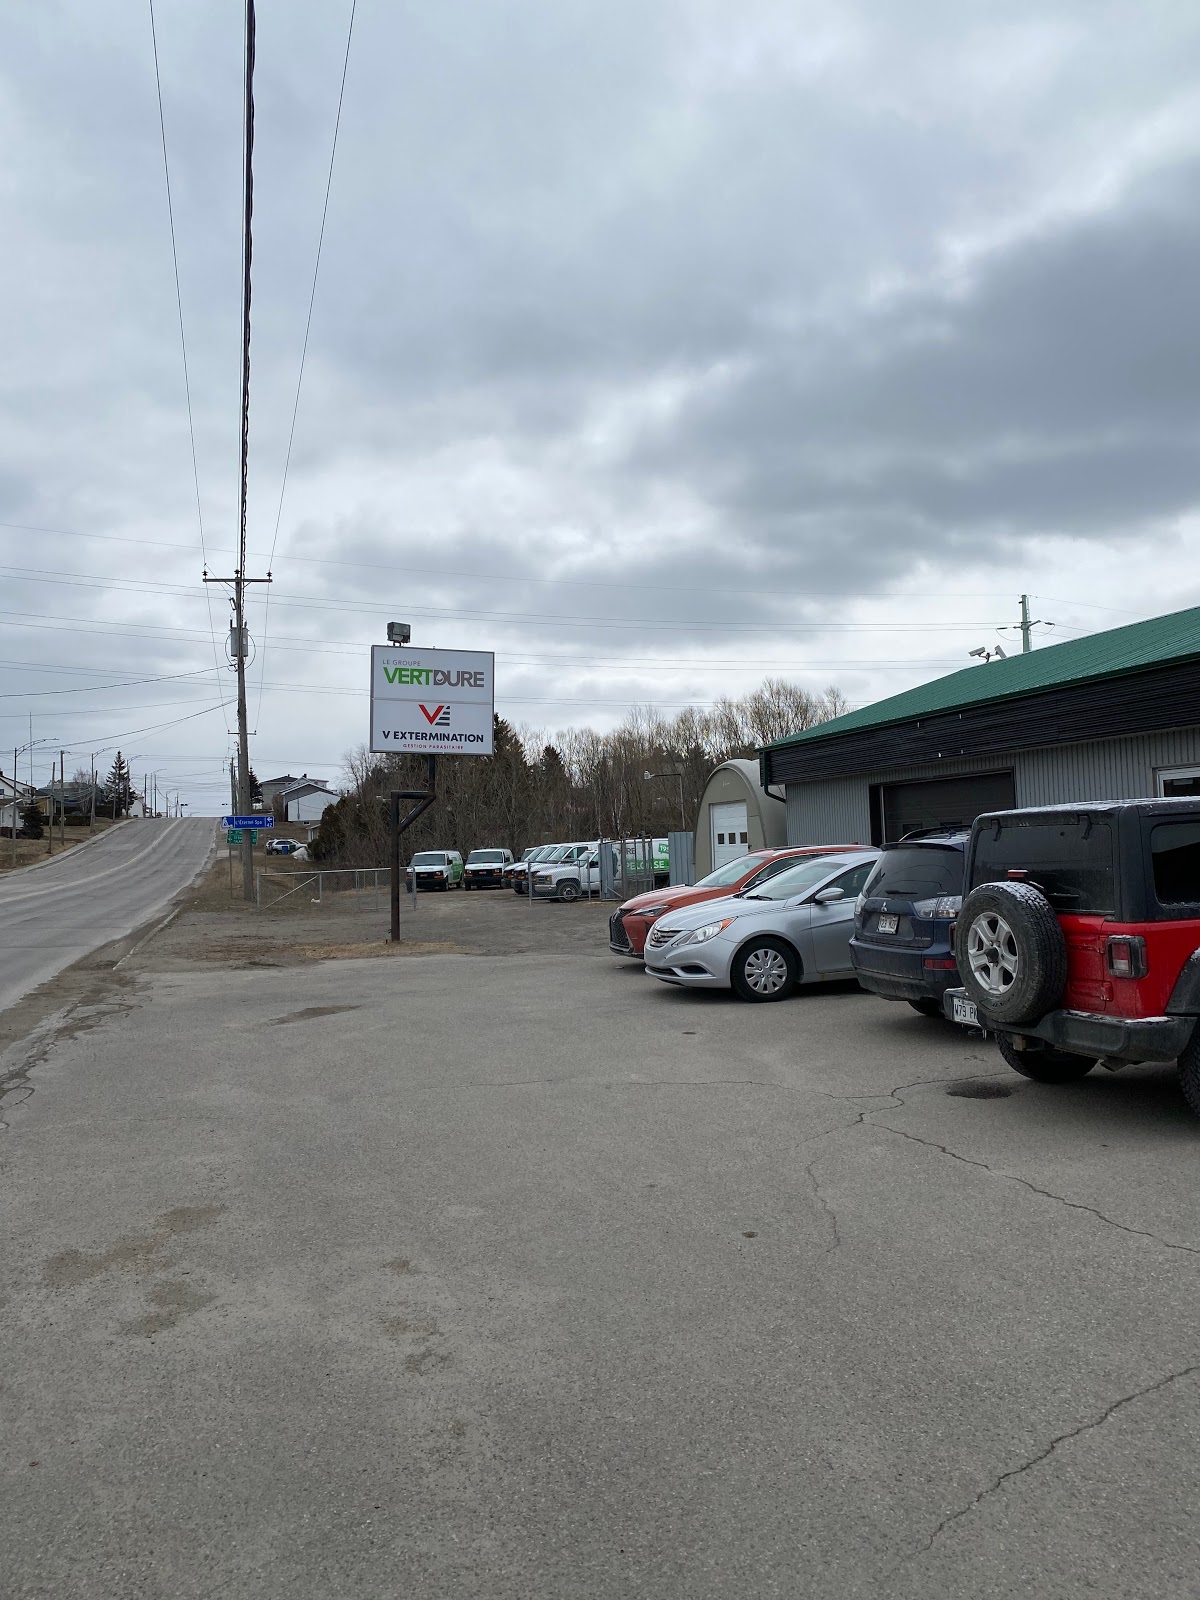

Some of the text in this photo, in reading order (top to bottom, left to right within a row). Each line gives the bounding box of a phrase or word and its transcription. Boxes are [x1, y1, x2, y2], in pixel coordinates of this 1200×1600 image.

[392, 659, 421, 667] GROUPE
[383, 666, 485, 688] VERTDURE
[382, 730, 484, 743] V EXTERMINATION
